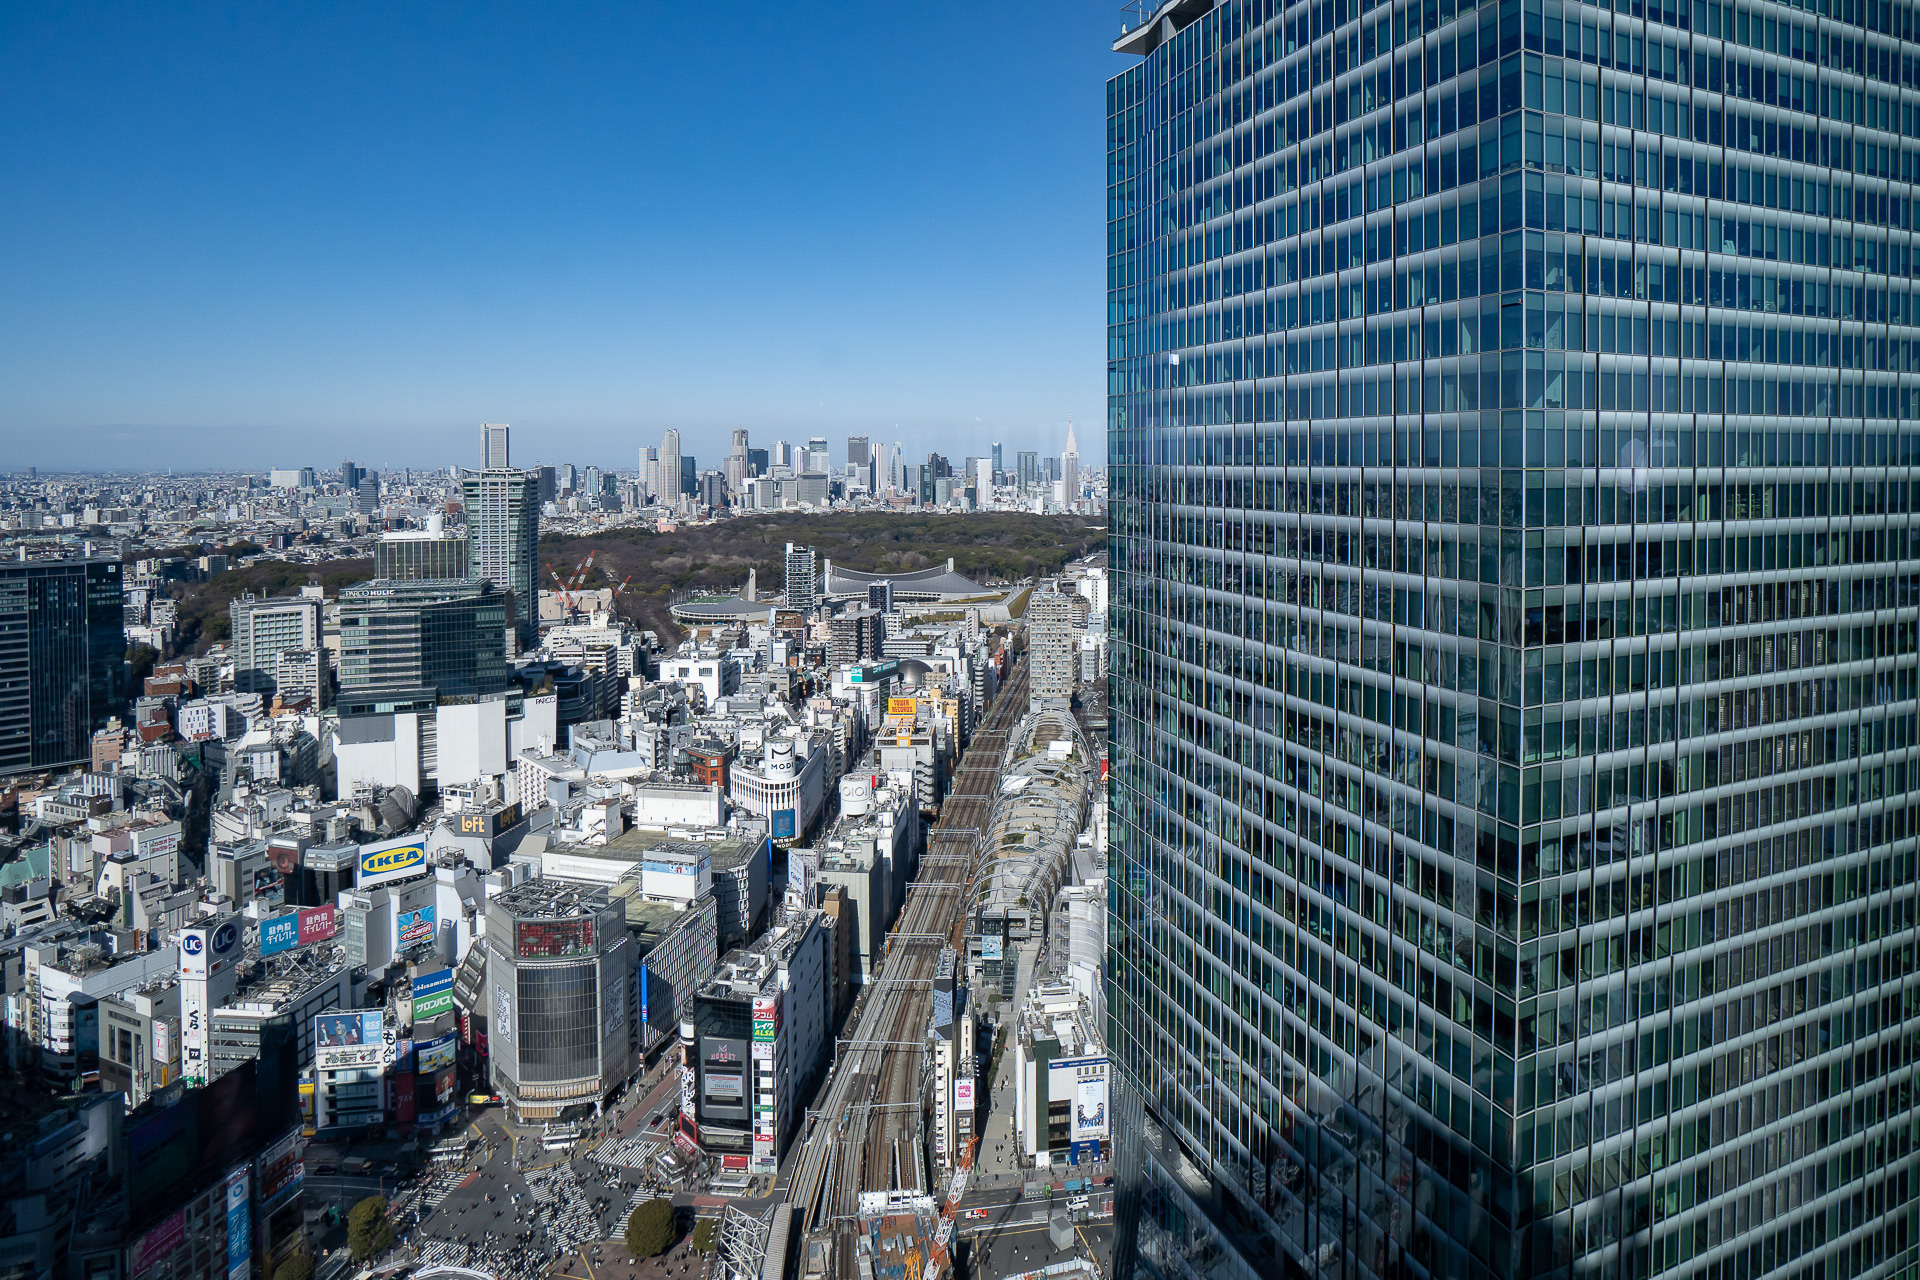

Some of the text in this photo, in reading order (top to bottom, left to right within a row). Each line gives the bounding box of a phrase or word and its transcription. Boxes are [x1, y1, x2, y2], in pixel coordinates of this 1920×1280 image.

[535, 697, 556, 705] PARCO
[770, 761, 794, 770] MODI
[368, 850, 420, 869] IKEA
[184, 939, 202, 951] UC
[416, 995, 451, 1013] サロンパス
[753, 1011, 773, 1019] アコム
[754, 1022, 774, 1030] レイク
[431, 1037, 445, 1047] DHC
